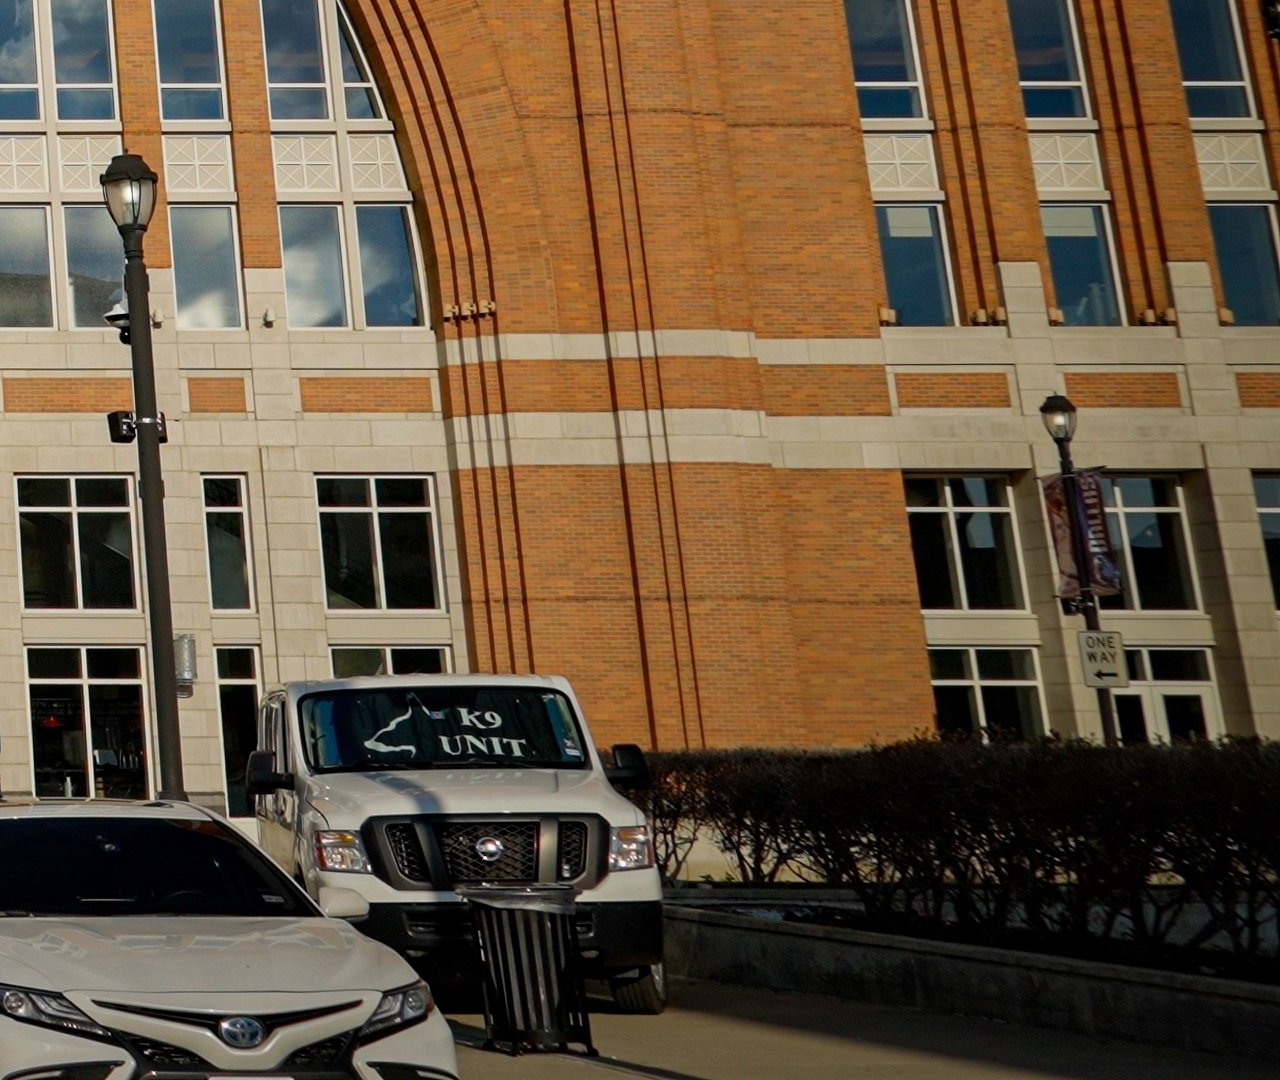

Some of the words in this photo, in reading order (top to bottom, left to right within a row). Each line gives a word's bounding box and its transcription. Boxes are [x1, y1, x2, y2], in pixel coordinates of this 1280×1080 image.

[1086, 636, 1116, 648] ONE
[1086, 651, 1117, 663] WAY
[456, 707, 503, 729] K9
[438, 734, 527, 758] UNIT
